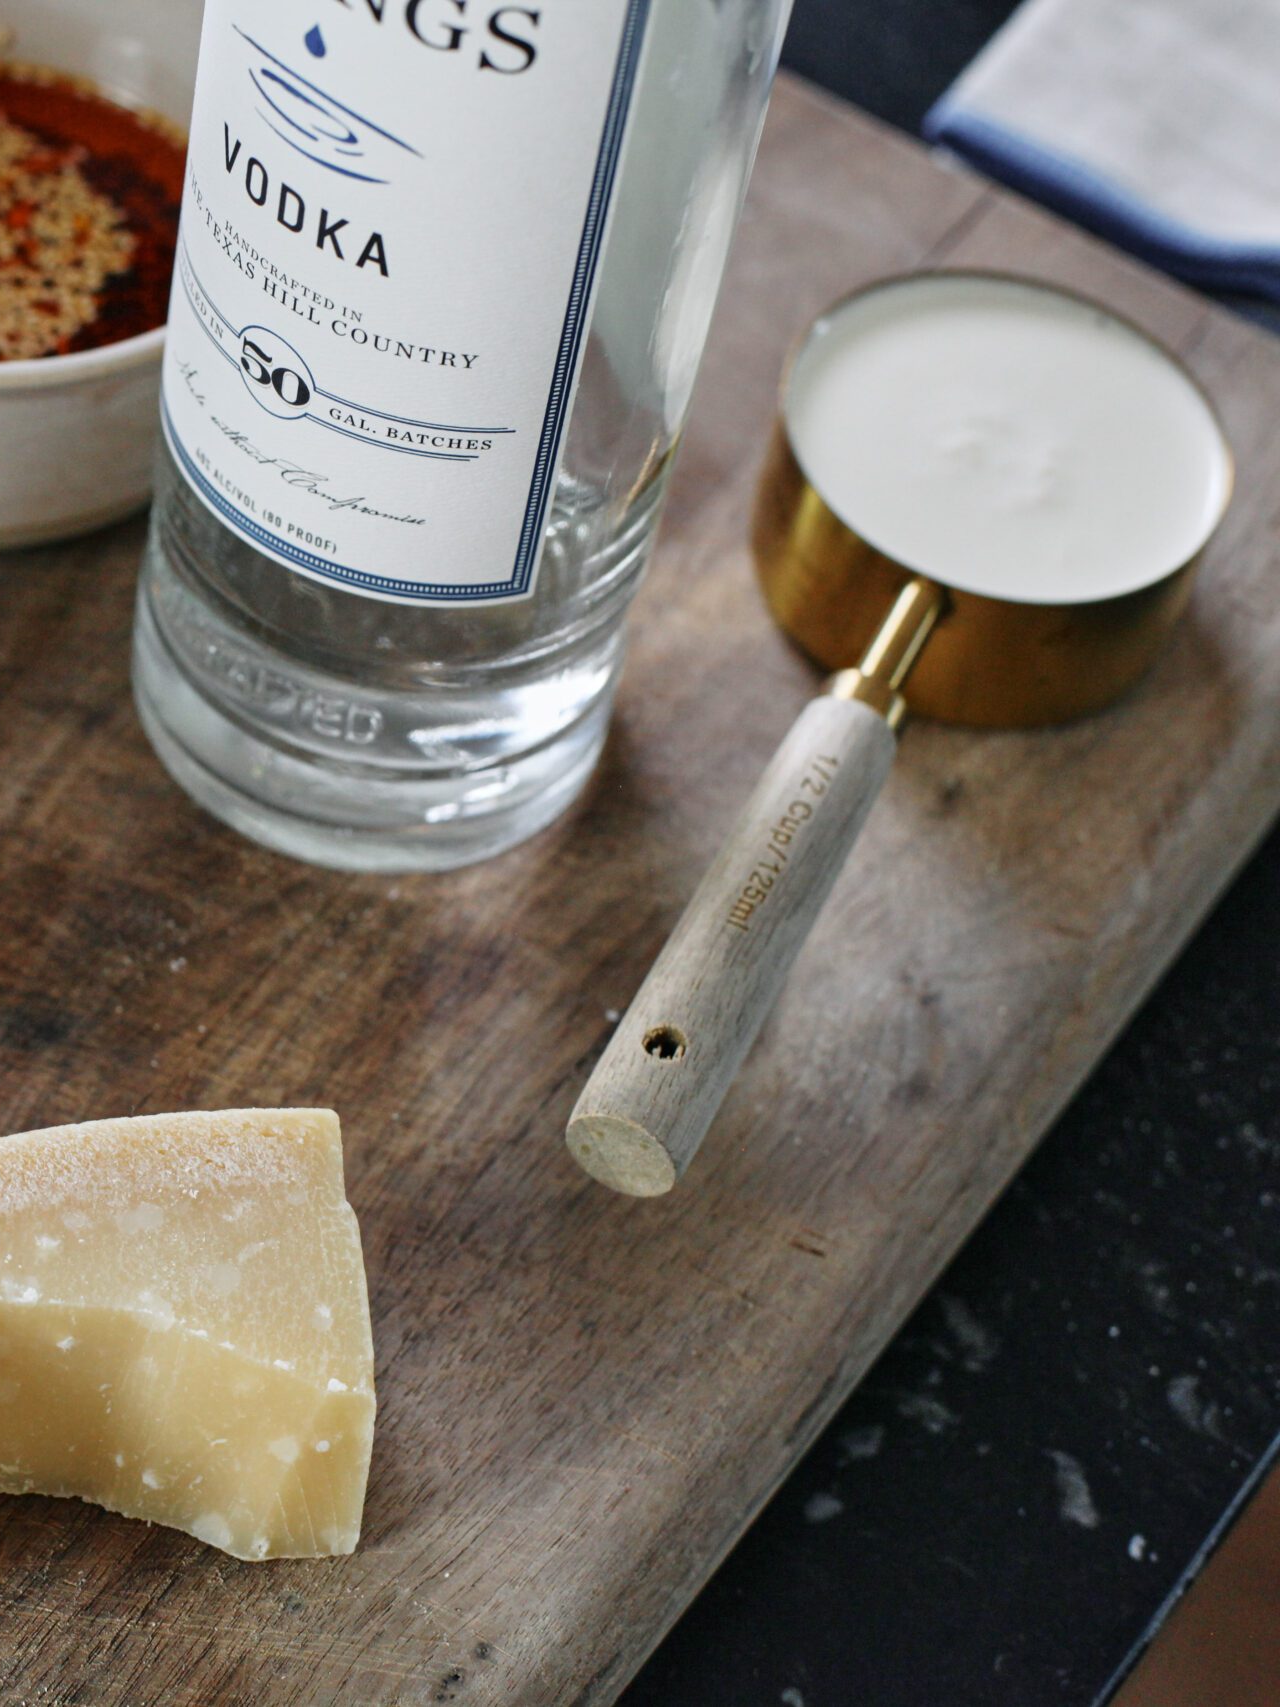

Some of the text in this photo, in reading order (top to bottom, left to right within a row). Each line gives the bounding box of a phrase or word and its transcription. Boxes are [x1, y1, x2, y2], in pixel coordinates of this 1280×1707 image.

[224, 121, 390, 278] VODKA
[205, 208, 255, 280] TEXAS
[263, 275, 321, 325] HILL
[331, 320, 480, 369] COUNTRY
[225, 221, 335, 310] HANDCRAFTED
[342, 307, 364, 323] IN
[241, 336, 310, 406] 50
[329, 408, 492, 450] GAL. BATCHES
[288, 522, 337, 554] PROOF)
